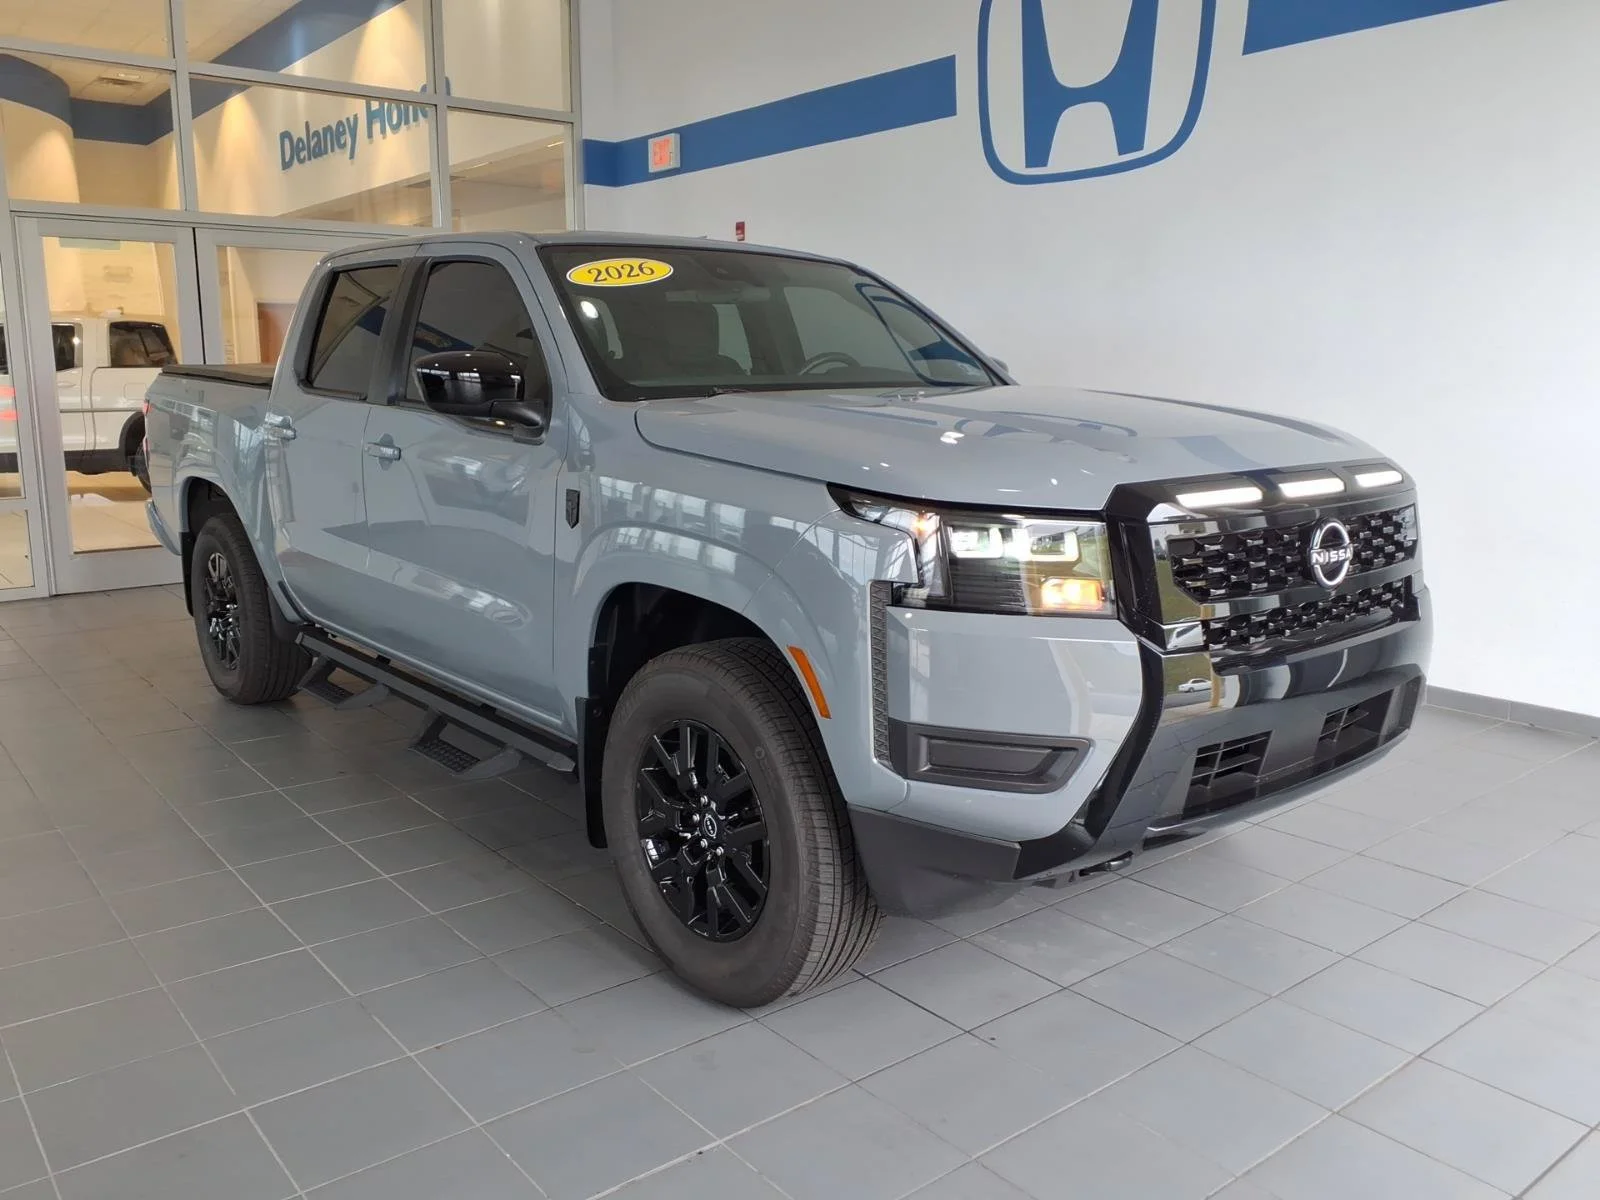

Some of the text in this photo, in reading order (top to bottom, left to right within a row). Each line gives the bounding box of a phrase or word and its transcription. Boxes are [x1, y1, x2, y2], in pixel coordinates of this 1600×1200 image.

[279, 113, 359, 171] Delaney
[587, 261, 655, 282] 2026
[1312, 547, 1353, 563] NISSA
